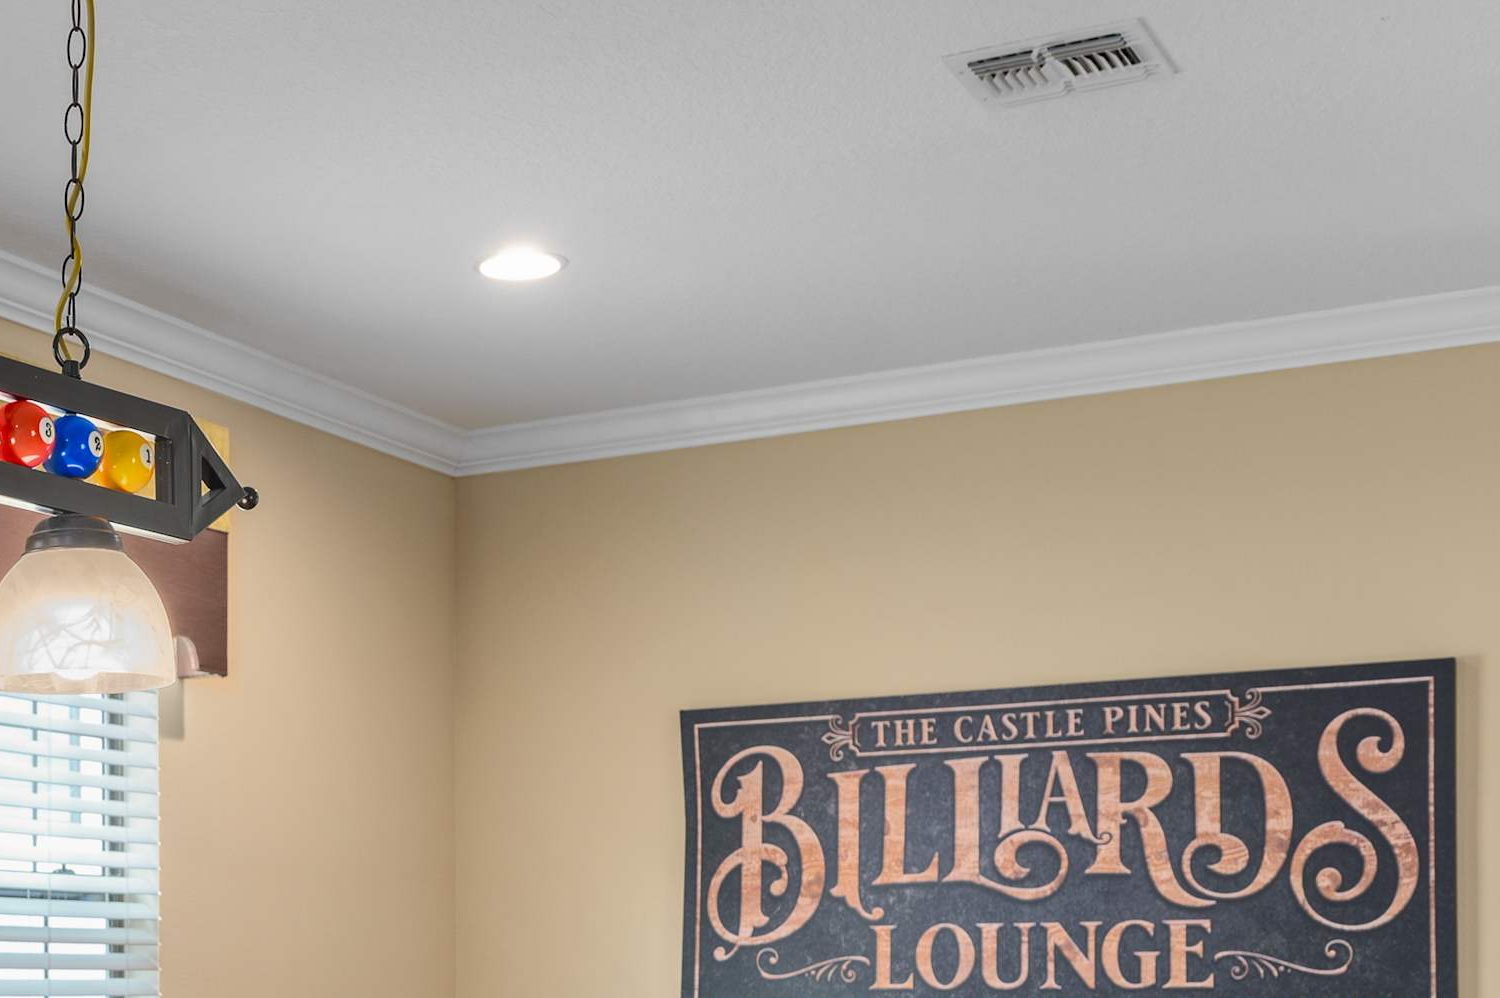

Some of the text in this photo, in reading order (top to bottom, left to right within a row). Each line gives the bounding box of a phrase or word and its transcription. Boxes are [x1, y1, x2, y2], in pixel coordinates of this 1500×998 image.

[45, 422, 52, 438] 3
[94, 437, 101, 449] 2
[146, 449, 151, 464] 1
[870, 700, 1213, 748] THE CASTLE PINES
[706, 706, 1421, 962] BILLIARDS
[869, 919, 1215, 991] LOUNGE
